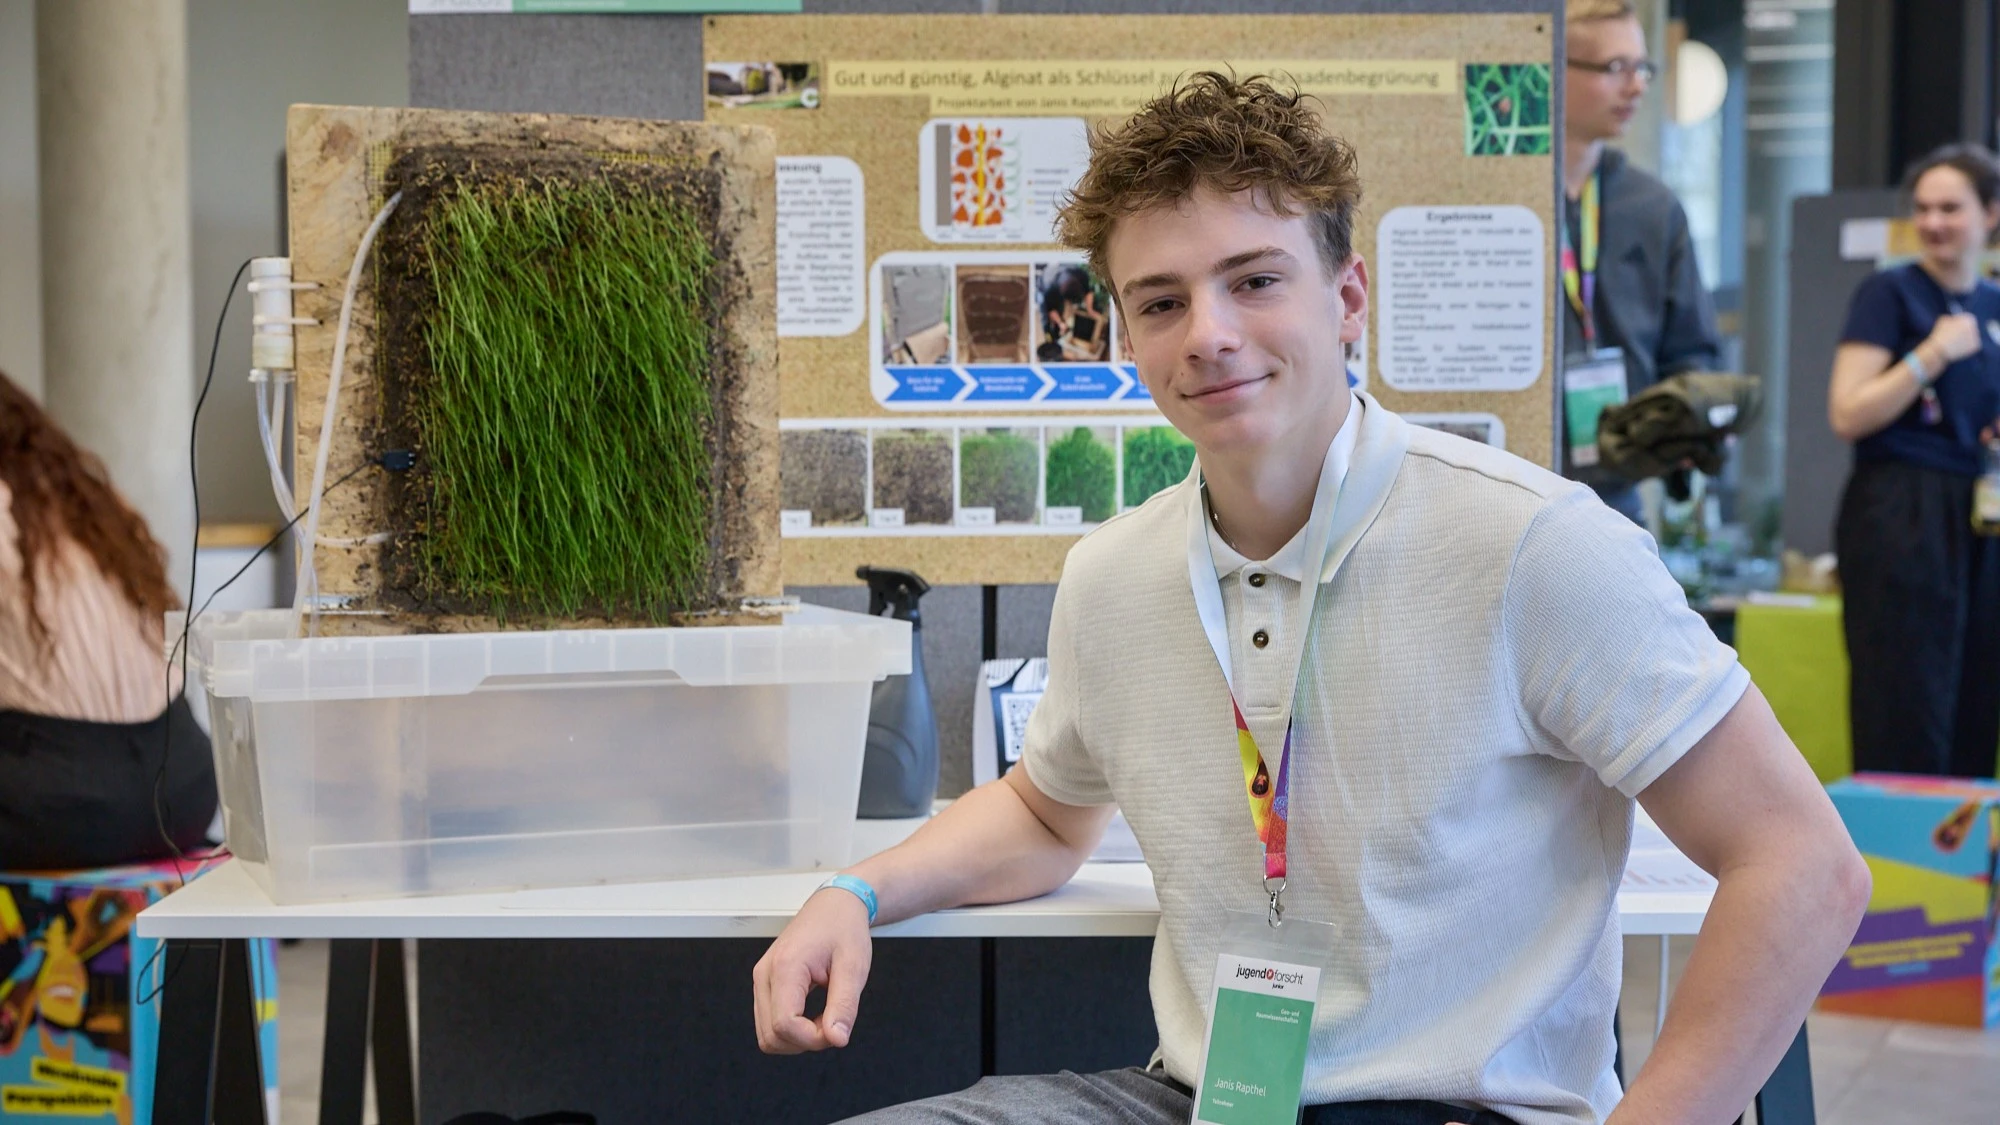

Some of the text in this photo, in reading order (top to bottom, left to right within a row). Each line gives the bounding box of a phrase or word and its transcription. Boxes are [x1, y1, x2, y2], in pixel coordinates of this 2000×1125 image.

[834, 69, 866, 86] Gut
[871, 70, 905, 86] und
[909, 70, 977, 90] günstig,
[982, 69, 1042, 88] Alginat
[1048, 69, 1071, 85] als
[1076, 68, 1154, 85] Schlüssel
[938, 96, 1012, 109] Projektarbeit
[1041, 96, 1068, 108] Janis
[1426, 211, 1493, 223] Ergebnisse
[1236, 964, 1304, 985] jugend forscht
[1214, 1078, 1267, 1097] Janis Rapthel
